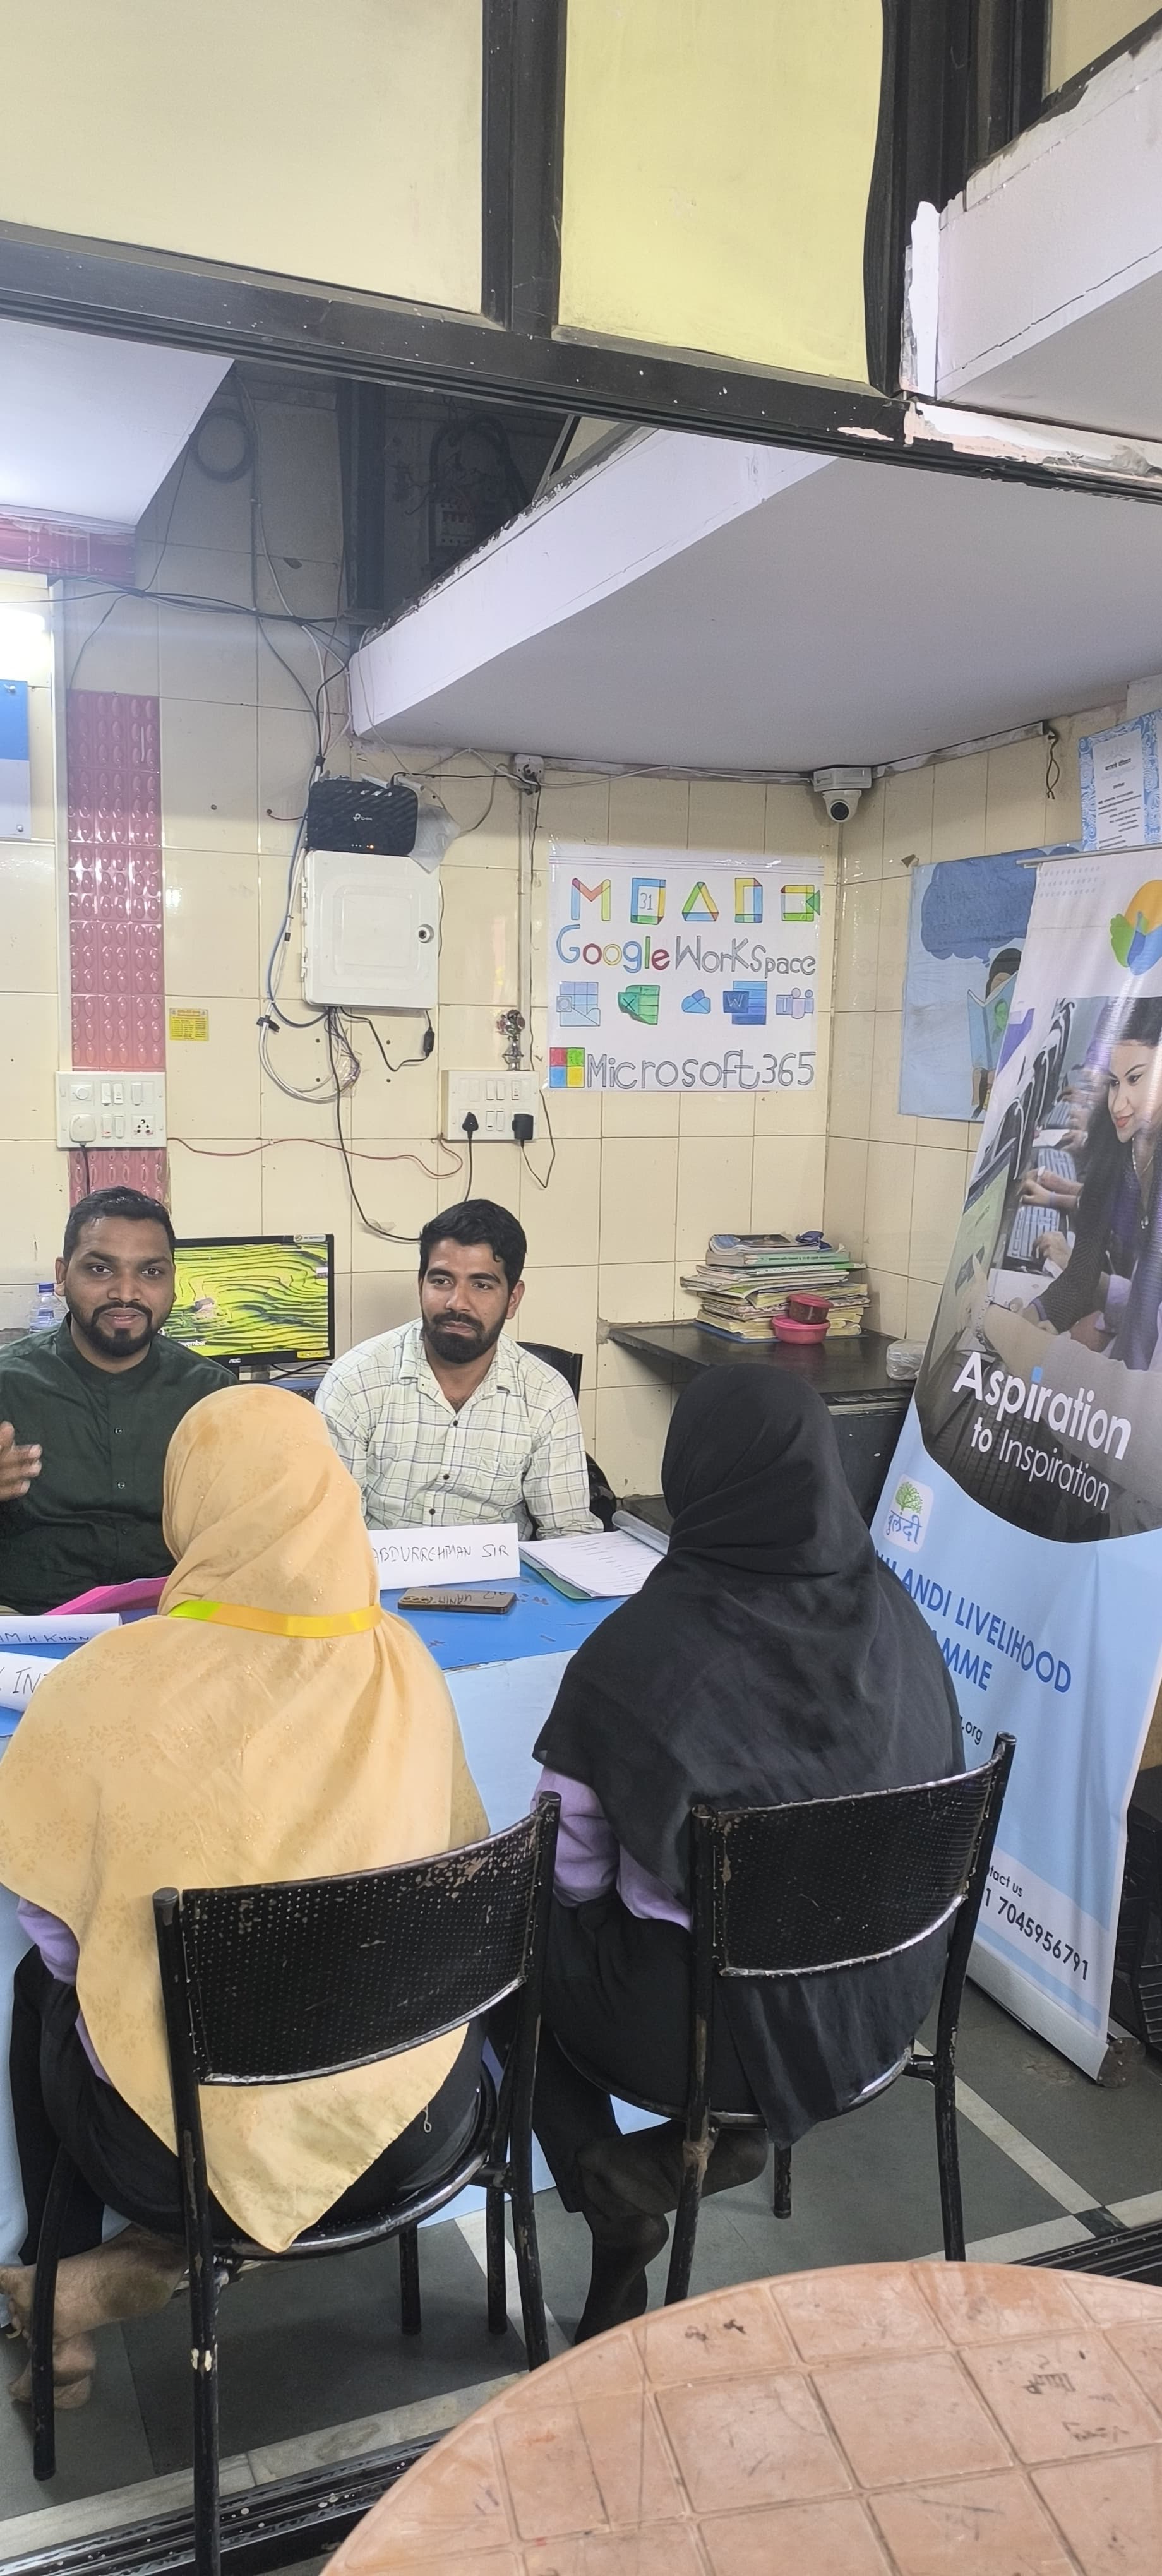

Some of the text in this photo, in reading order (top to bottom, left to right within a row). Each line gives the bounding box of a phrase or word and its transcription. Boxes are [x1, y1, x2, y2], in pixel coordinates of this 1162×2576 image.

[638, 893, 654, 910] 31
[556, 924, 669, 973] Google
[952, 1352, 1132, 1460] Aspiration
[971, 1417, 1110, 1511] to Inspiration
[481, 1544, 509, 1558] SIR
[955, 1597, 1072, 1693] LIVELIHOOD
[1012, 1882, 1023, 1897] us
[998, 1896, 1089, 1981] 7045956791
